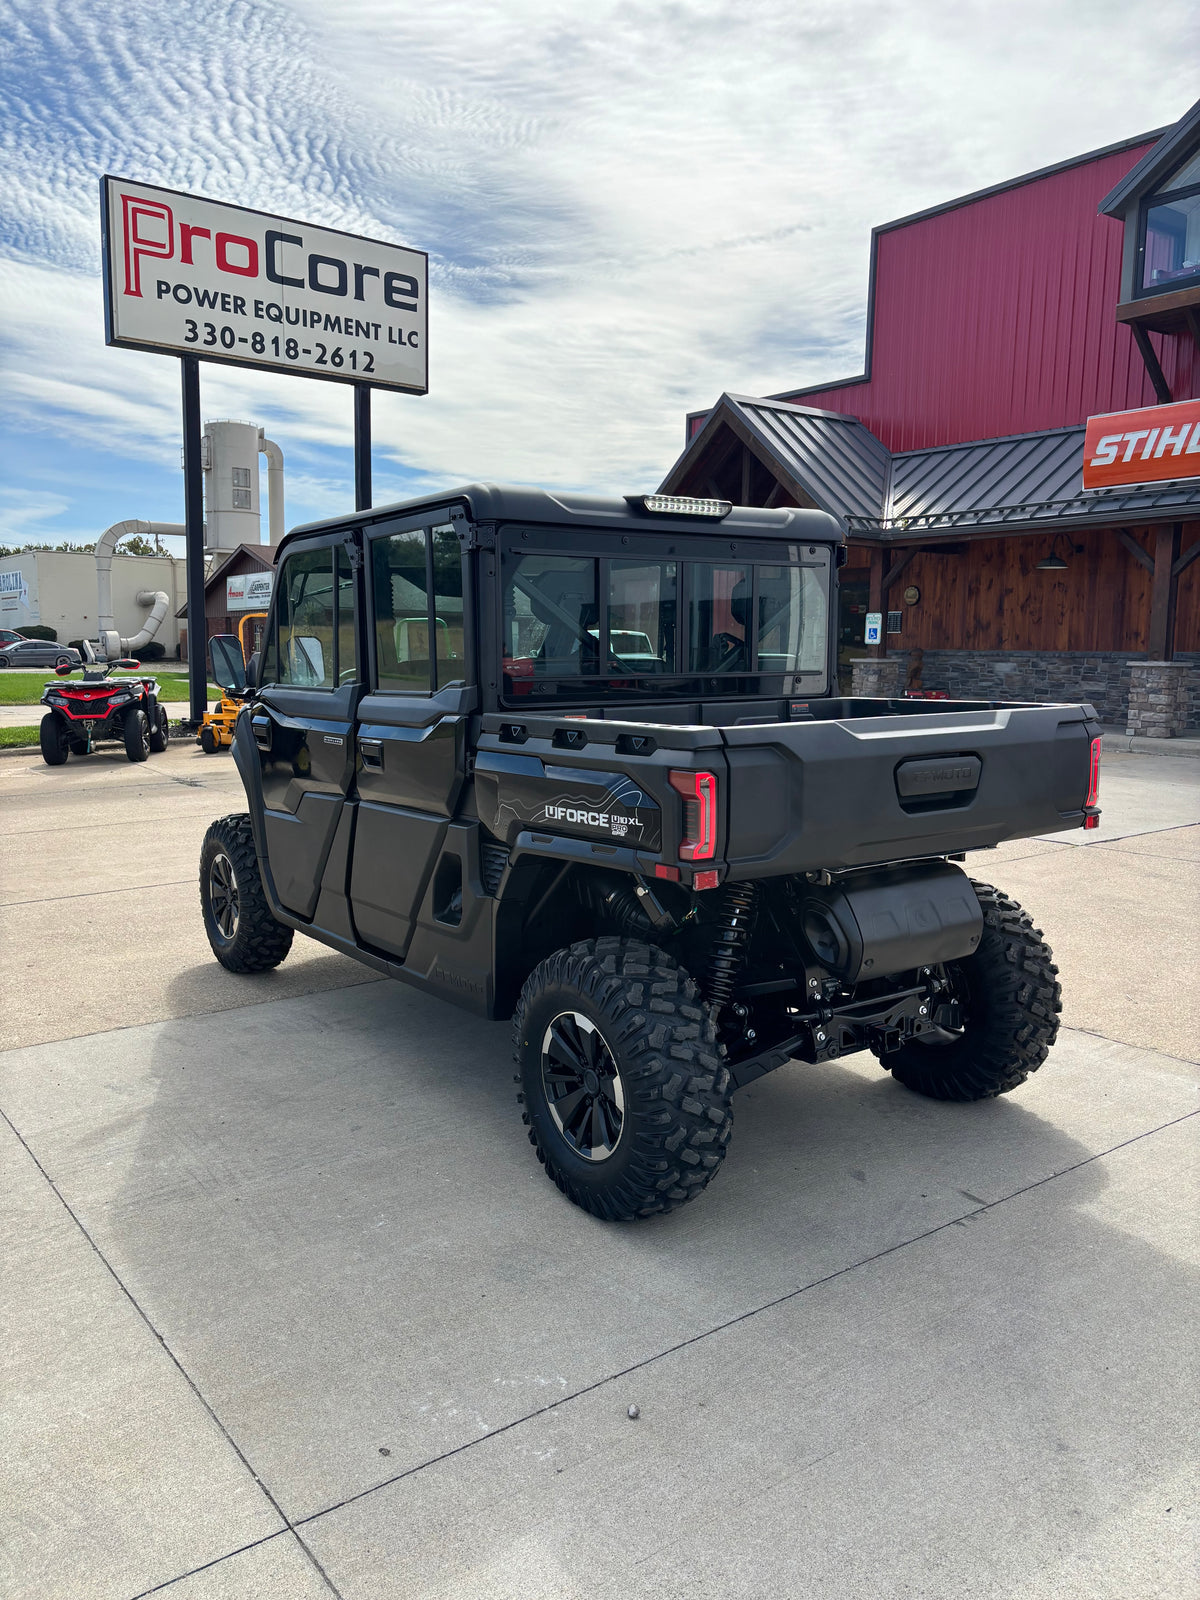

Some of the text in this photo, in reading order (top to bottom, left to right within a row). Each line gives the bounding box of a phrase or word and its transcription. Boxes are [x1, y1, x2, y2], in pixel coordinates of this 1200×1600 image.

[120, 194, 419, 312] ProCore
[156, 280, 419, 348] POWER EQUIPMENT LLC
[184, 319, 375, 373] 330-818-2612
[545, 805, 609, 828] UFORCE
